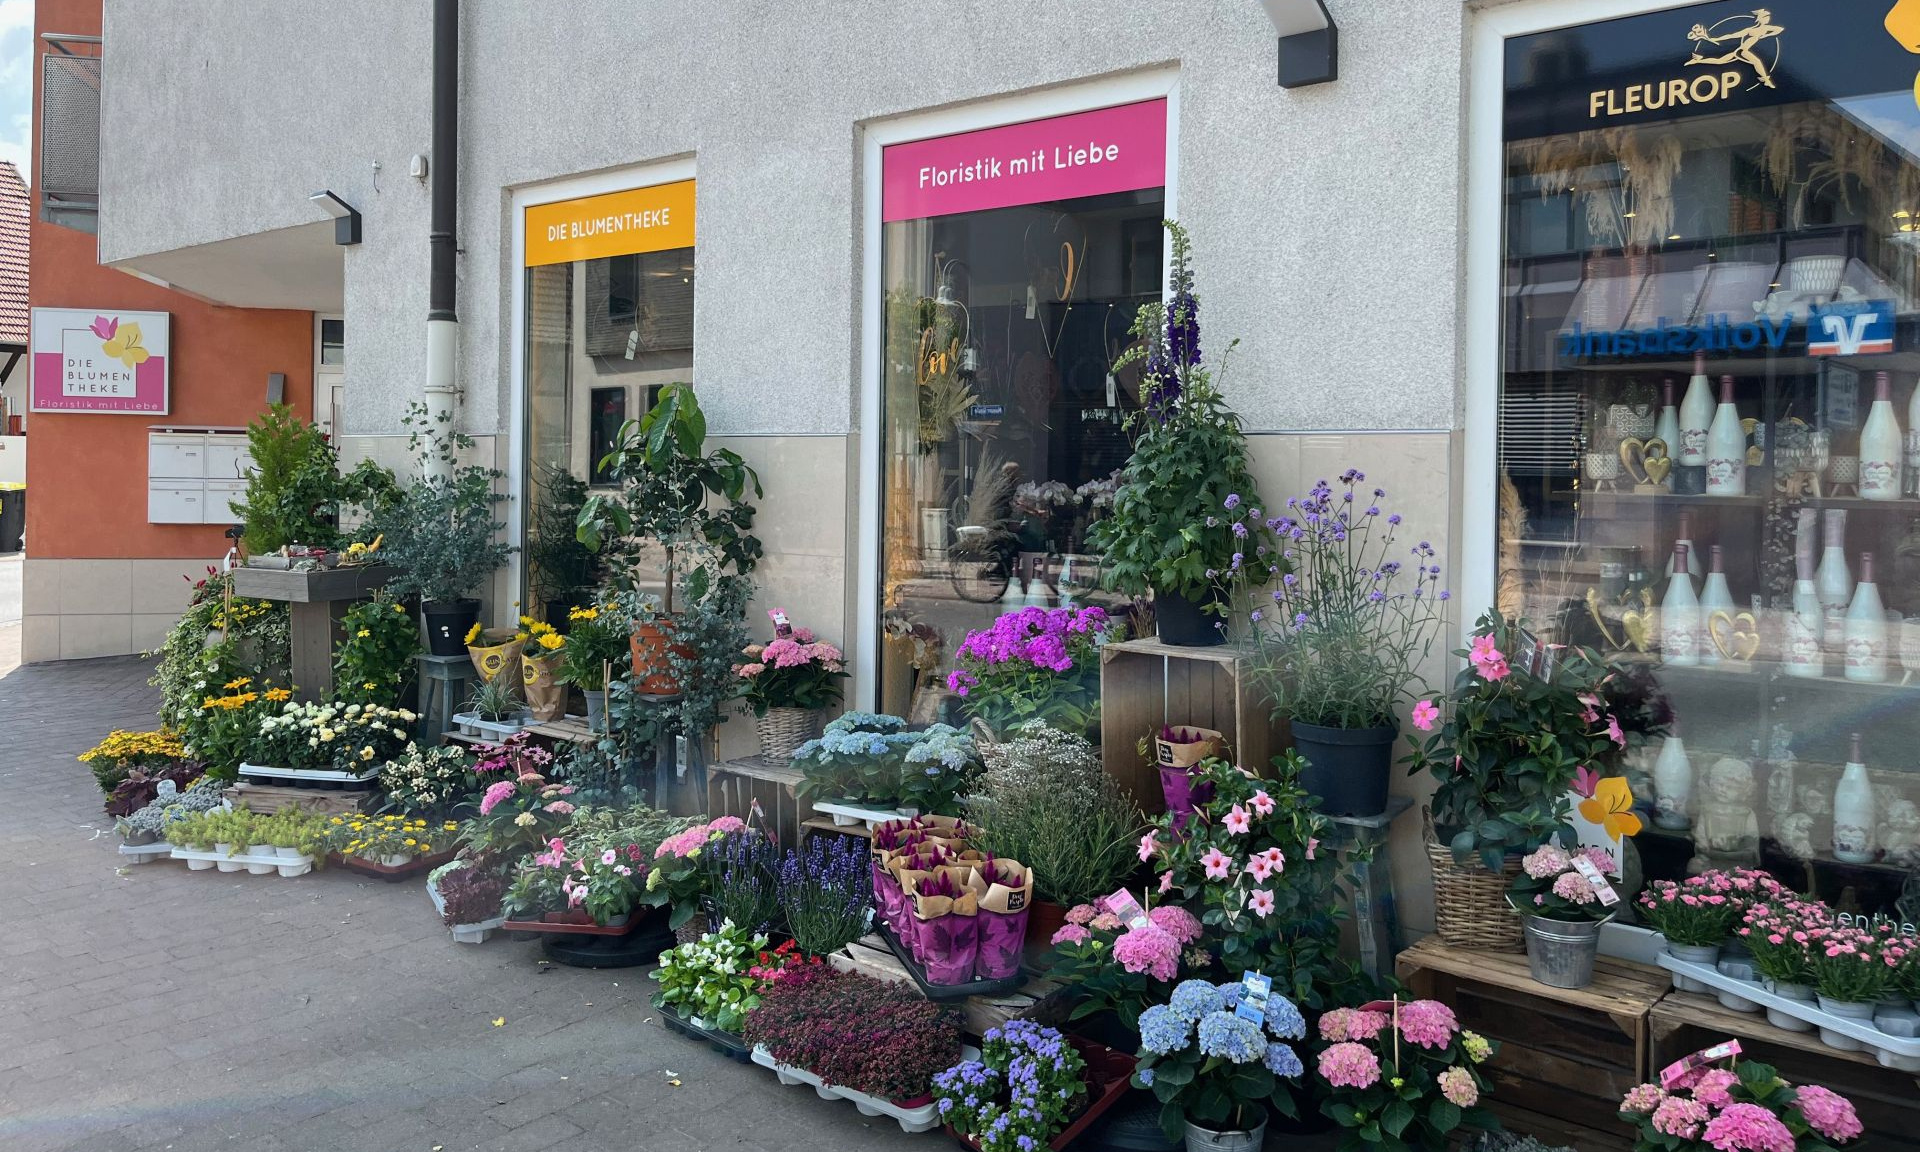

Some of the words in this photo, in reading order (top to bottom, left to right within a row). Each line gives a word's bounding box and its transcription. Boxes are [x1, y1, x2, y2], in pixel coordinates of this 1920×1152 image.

[1589, 71, 1741, 118] FLEUROP
[919, 157, 1002, 189] Floristik
[1009, 149, 1045, 176] mit
[1054, 142, 1119, 169] Liebe
[548, 223, 567, 242] DIE
[571, 208, 670, 238] BLUMENTHEKE
[68, 359, 92, 368] DIE
[68, 371, 130, 381] BLUMEN
[68, 383, 118, 393] THEKE
[40, 399, 93, 409] Floristik
[99, 401, 118, 410] mit
[124, 402, 158, 411] Liebe
